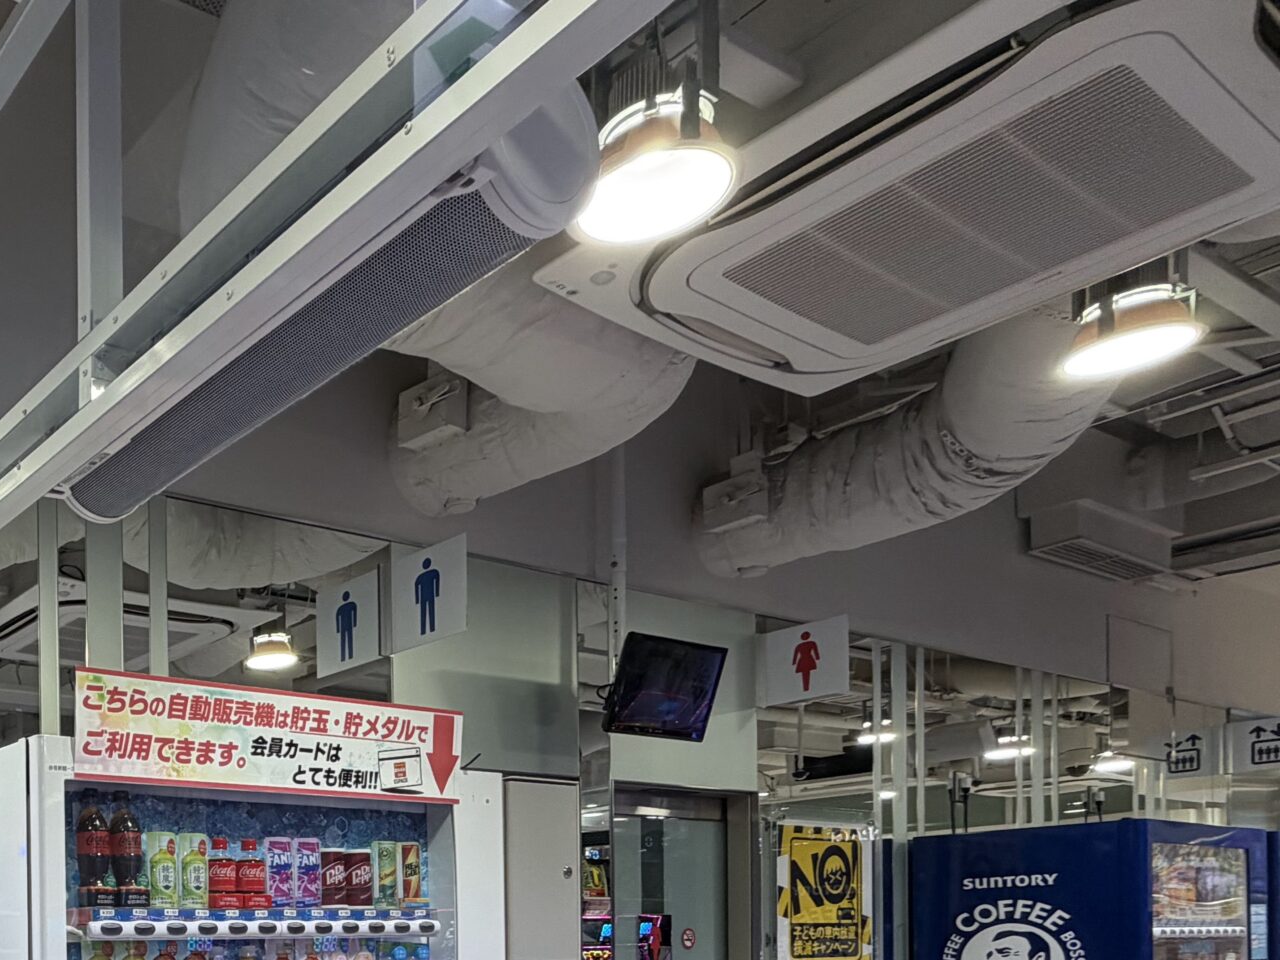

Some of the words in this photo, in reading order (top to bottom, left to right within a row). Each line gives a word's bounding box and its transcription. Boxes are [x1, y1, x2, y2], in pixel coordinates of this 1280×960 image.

[82, 684, 429, 743] こちらの自動販売機は貯玉・貯メダルで
[82, 731, 246, 769] ご利用できます。
[251, 736, 342, 762] 会員カードは
[955, 899, 1071, 932] COFFEE
